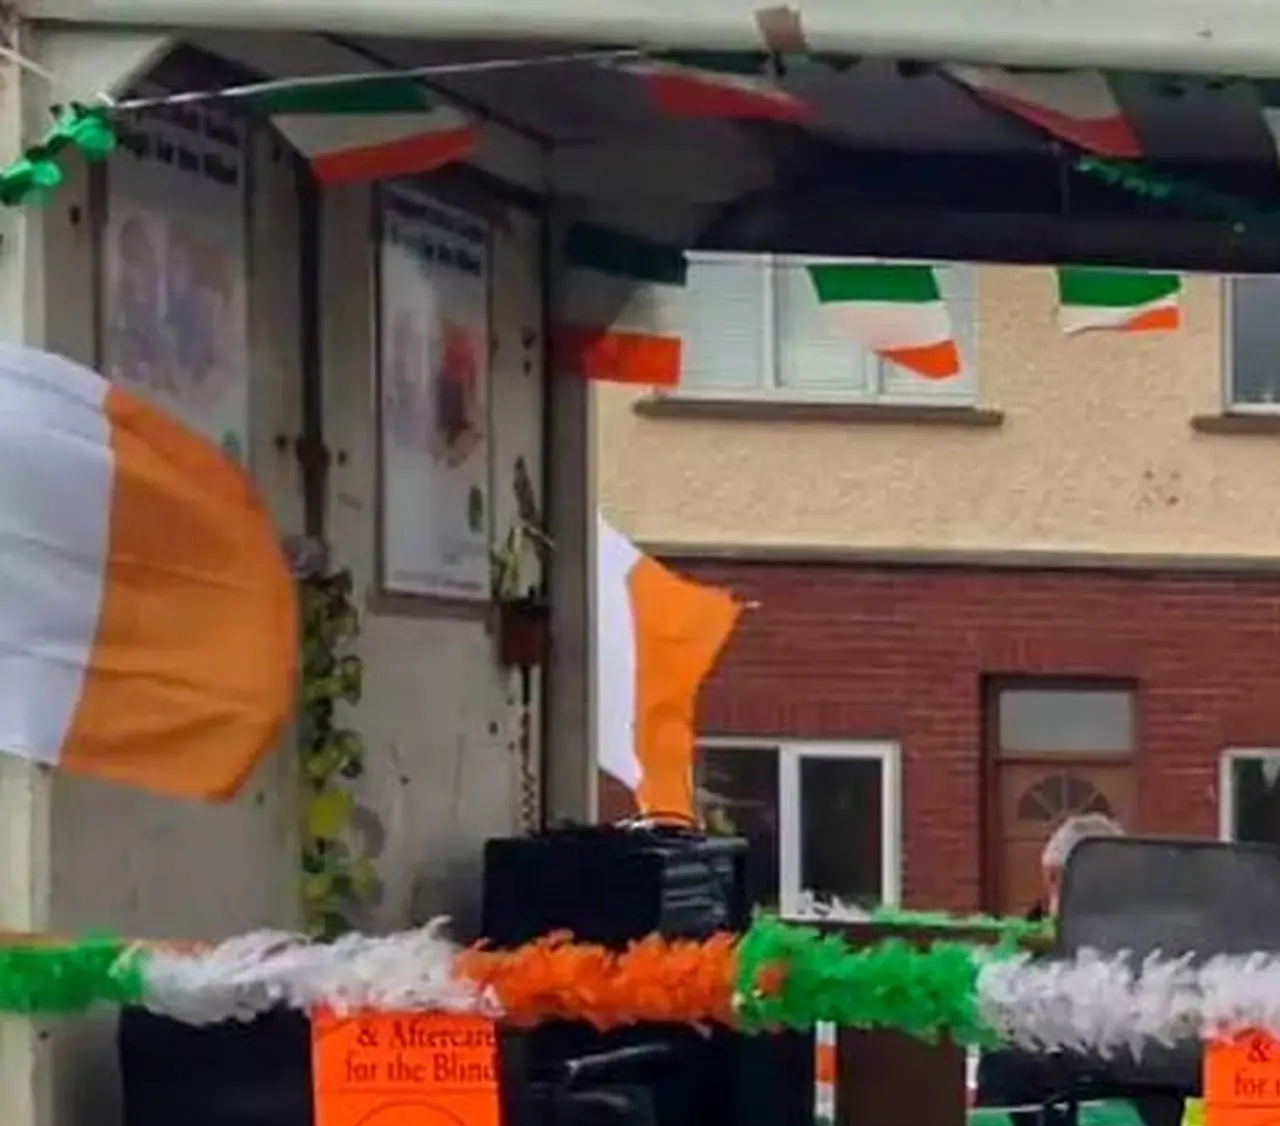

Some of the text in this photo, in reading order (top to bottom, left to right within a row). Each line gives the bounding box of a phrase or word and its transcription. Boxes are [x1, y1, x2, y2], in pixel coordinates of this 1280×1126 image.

[356, 1028, 378, 1047] &
[1247, 1036, 1272, 1063] &
[346, 1049, 377, 1082] for
[388, 1052, 427, 1082] the
[1234, 1067, 1267, 1097] for
